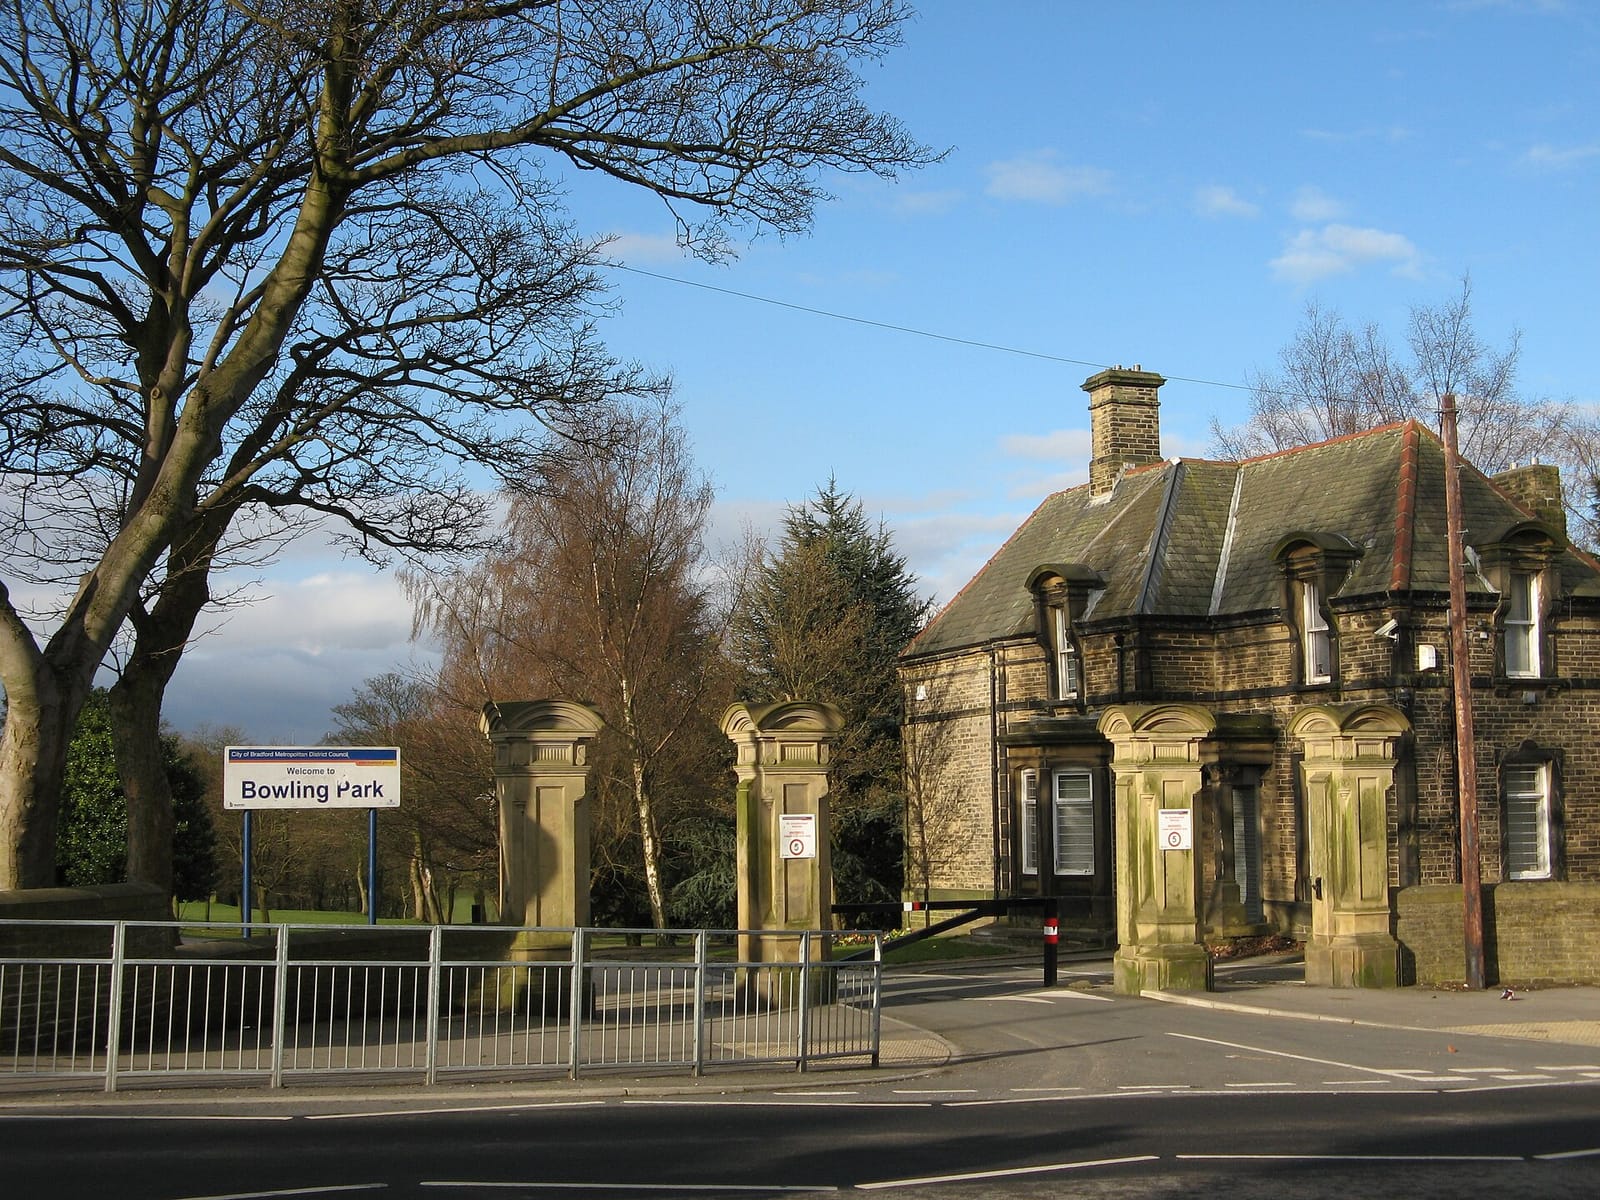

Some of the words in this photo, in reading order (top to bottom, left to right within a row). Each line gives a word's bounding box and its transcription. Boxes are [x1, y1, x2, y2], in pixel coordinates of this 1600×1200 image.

[287, 767, 325, 775] Welcome
[242, 780, 329, 803] Bowling
[337, 780, 384, 798] Park
